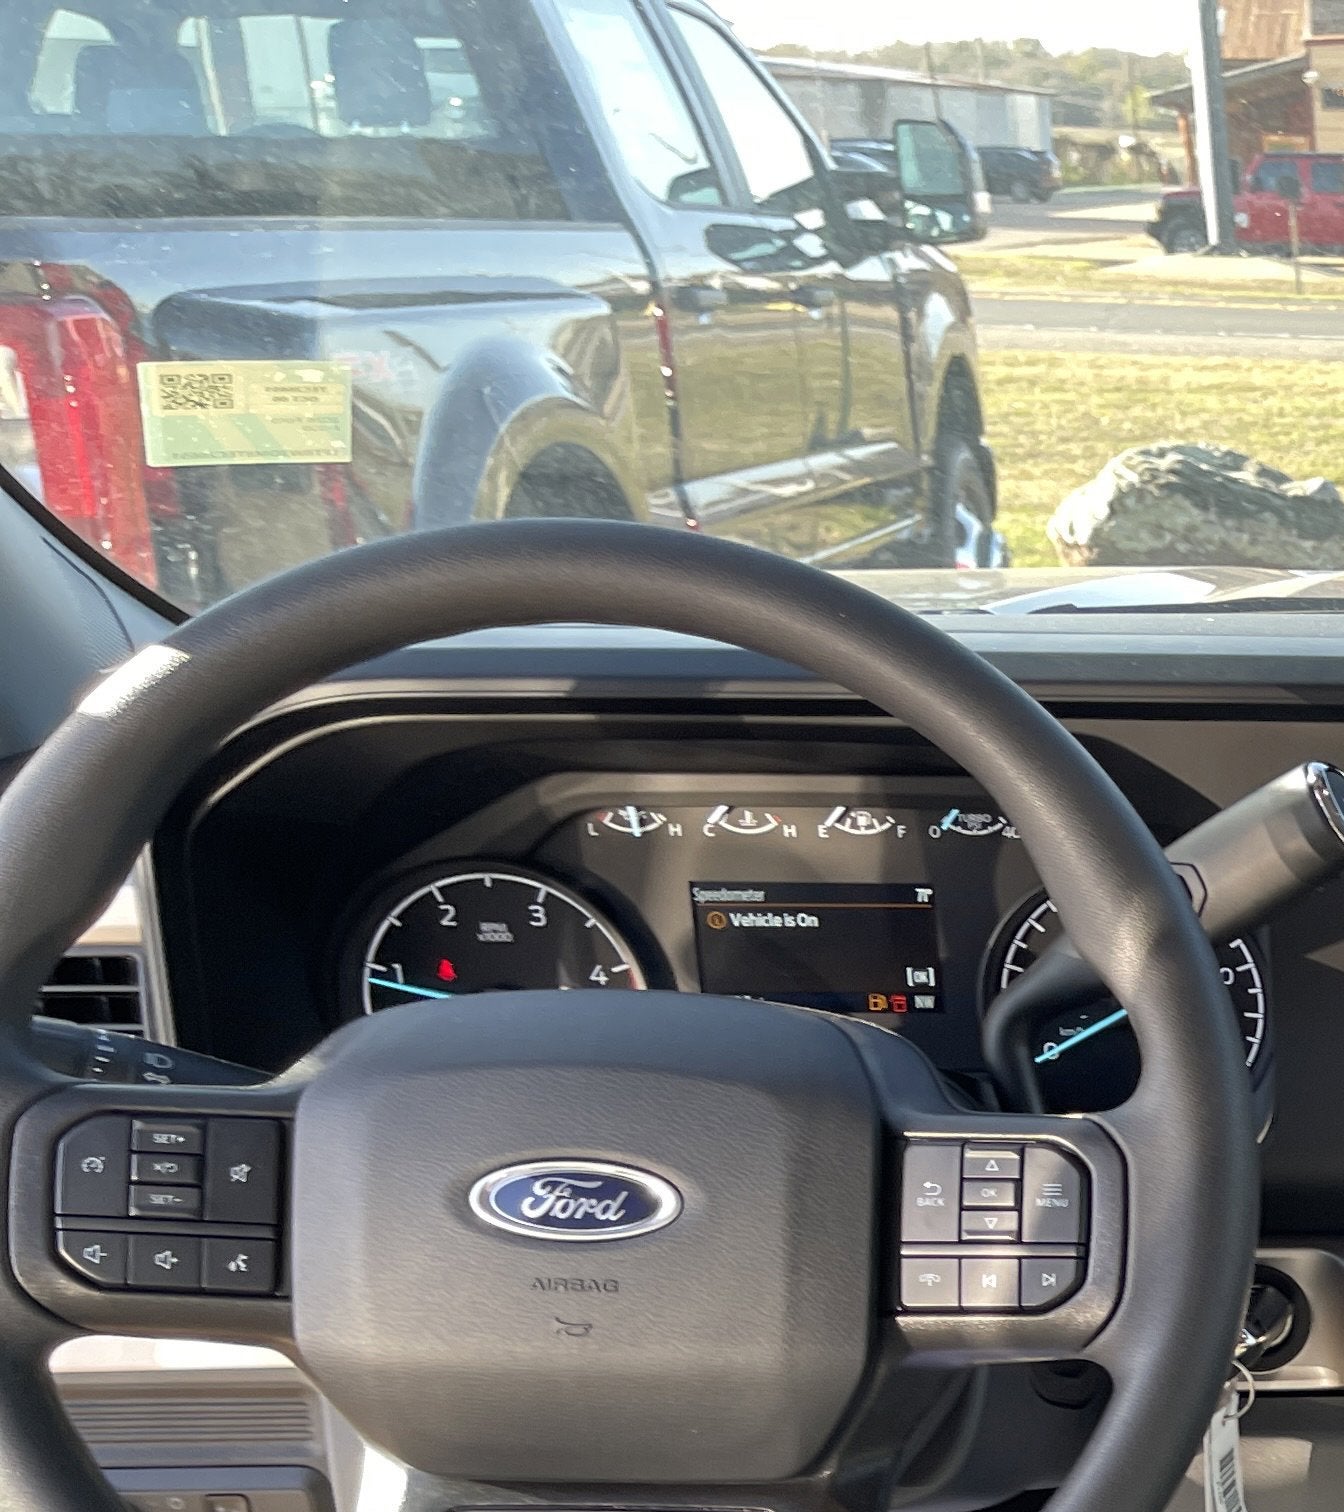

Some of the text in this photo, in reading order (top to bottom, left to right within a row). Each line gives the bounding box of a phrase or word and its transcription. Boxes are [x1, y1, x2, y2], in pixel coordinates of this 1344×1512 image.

[438, 903, 458, 927] 2
[527, 904, 548, 927] 3
[728, 911, 820, 928] Vehicle is On
[520, 1176, 630, 1221] Ford
[530, 1276, 621, 1293] AIRBAG
